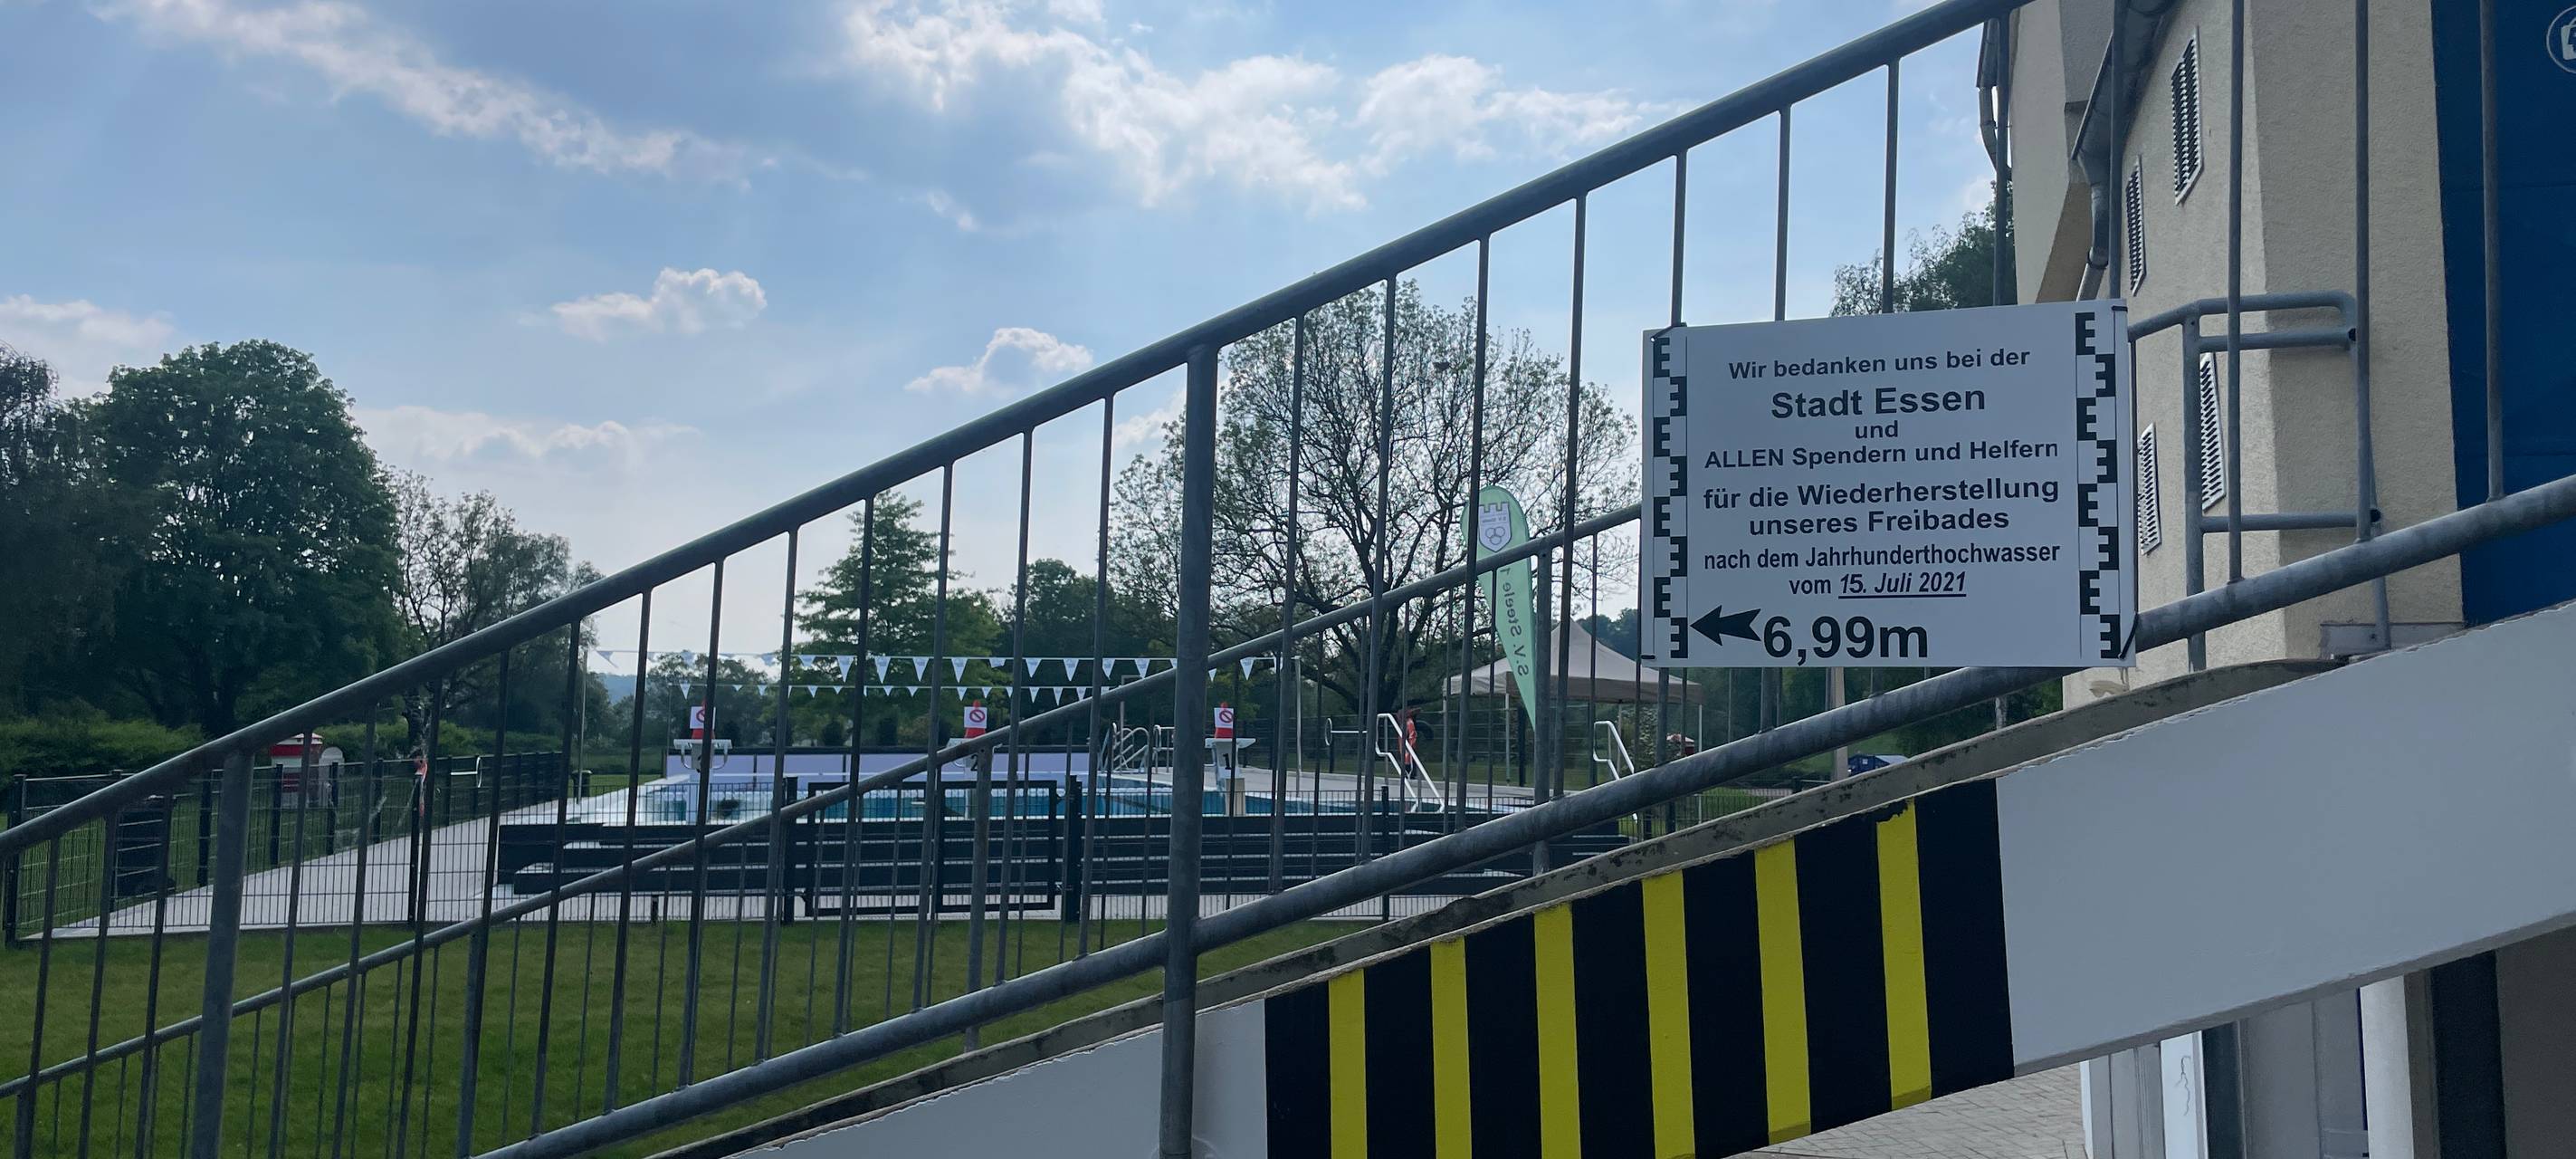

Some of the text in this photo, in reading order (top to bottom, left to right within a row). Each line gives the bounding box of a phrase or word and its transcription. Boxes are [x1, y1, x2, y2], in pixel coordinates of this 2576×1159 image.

[1728, 348, 2030, 379] Wir bedanken uns bei der
[1770, 387, 1985, 419] Stadt Essen
[1855, 419, 1899, 439] und
[1703, 439, 2058, 470] ALLEN Spendern und Helfern
[1703, 477, 2060, 510] für die Wiederherstellung
[1750, 507, 2009, 537] unseres Freibades
[1704, 541, 2061, 570] nach dem Jahrhunderthochwasser
[1789, 570, 1967, 595] vom 15. Juli 2021
[1762, 616, 1929, 666] 6,99m
